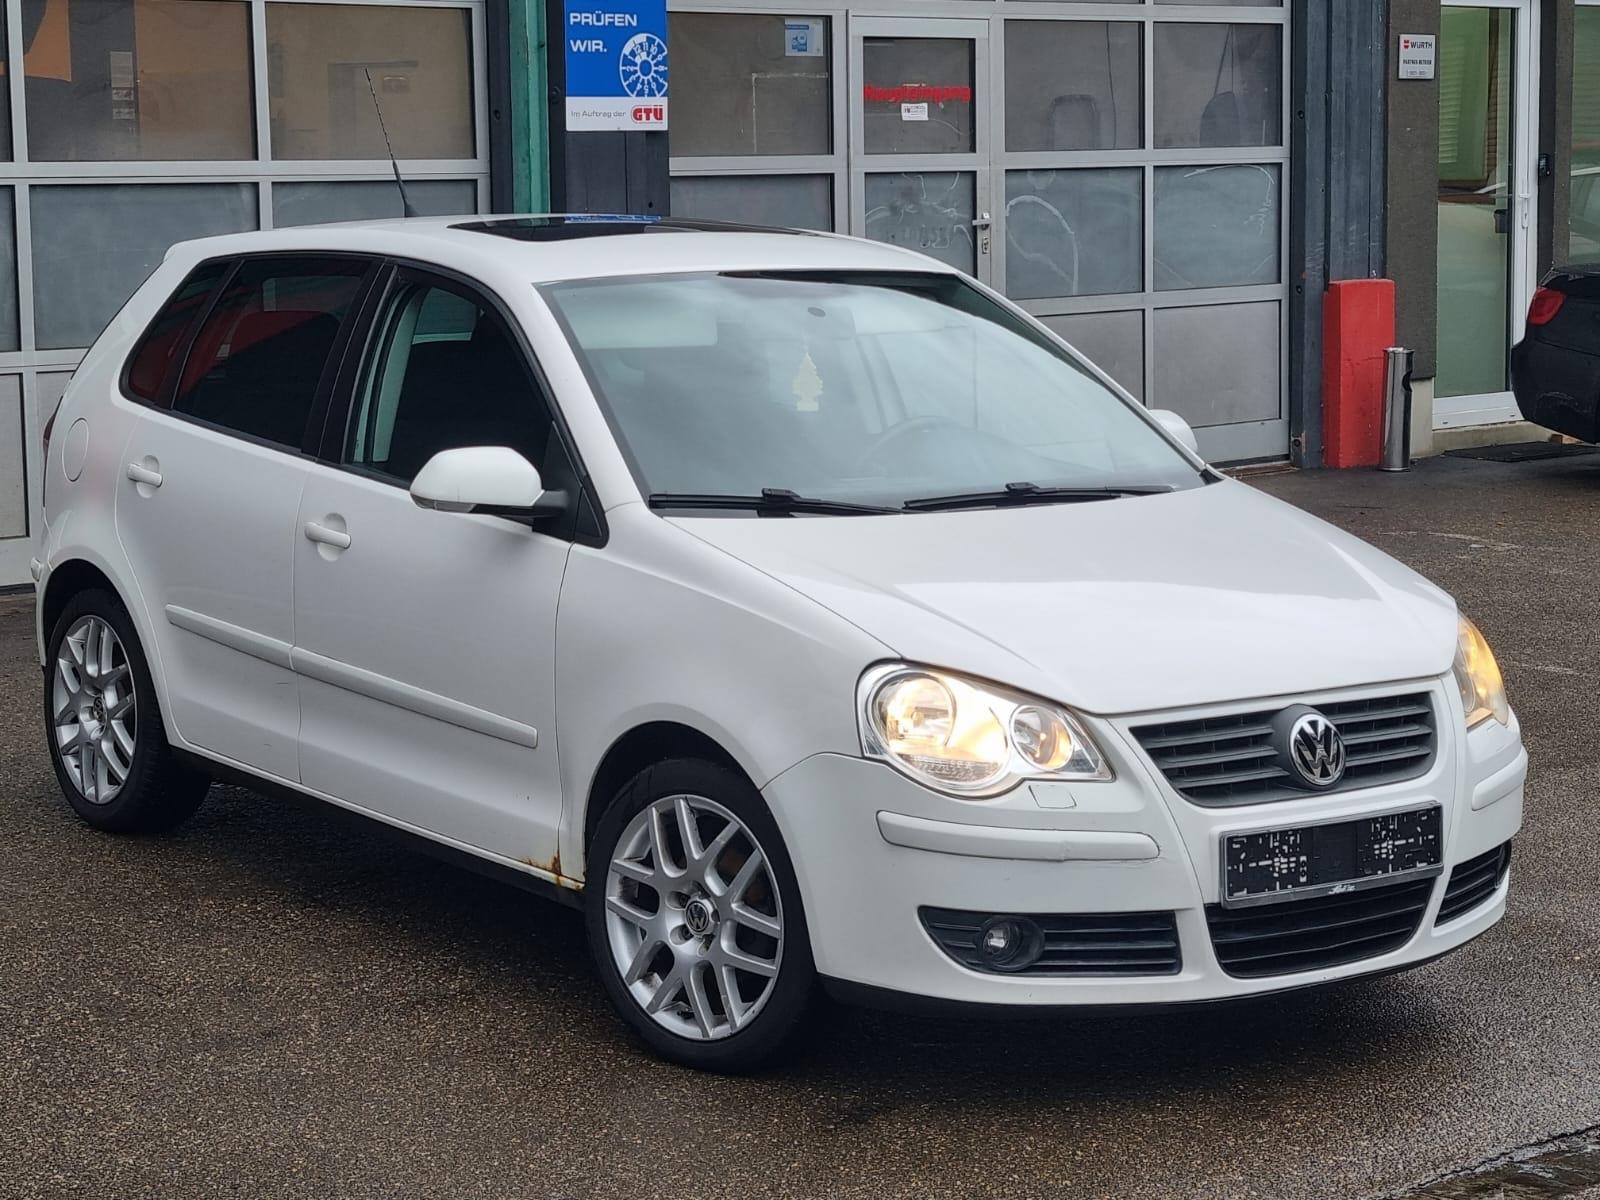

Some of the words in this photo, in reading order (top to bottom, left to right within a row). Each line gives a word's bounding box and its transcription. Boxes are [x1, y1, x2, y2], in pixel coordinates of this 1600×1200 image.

[569, 10, 638, 27] PRÜFEN
[569, 39, 608, 53] WIR.
[581, 110, 612, 119] Auftrag
[632, 104, 664, 121] GTÜ
